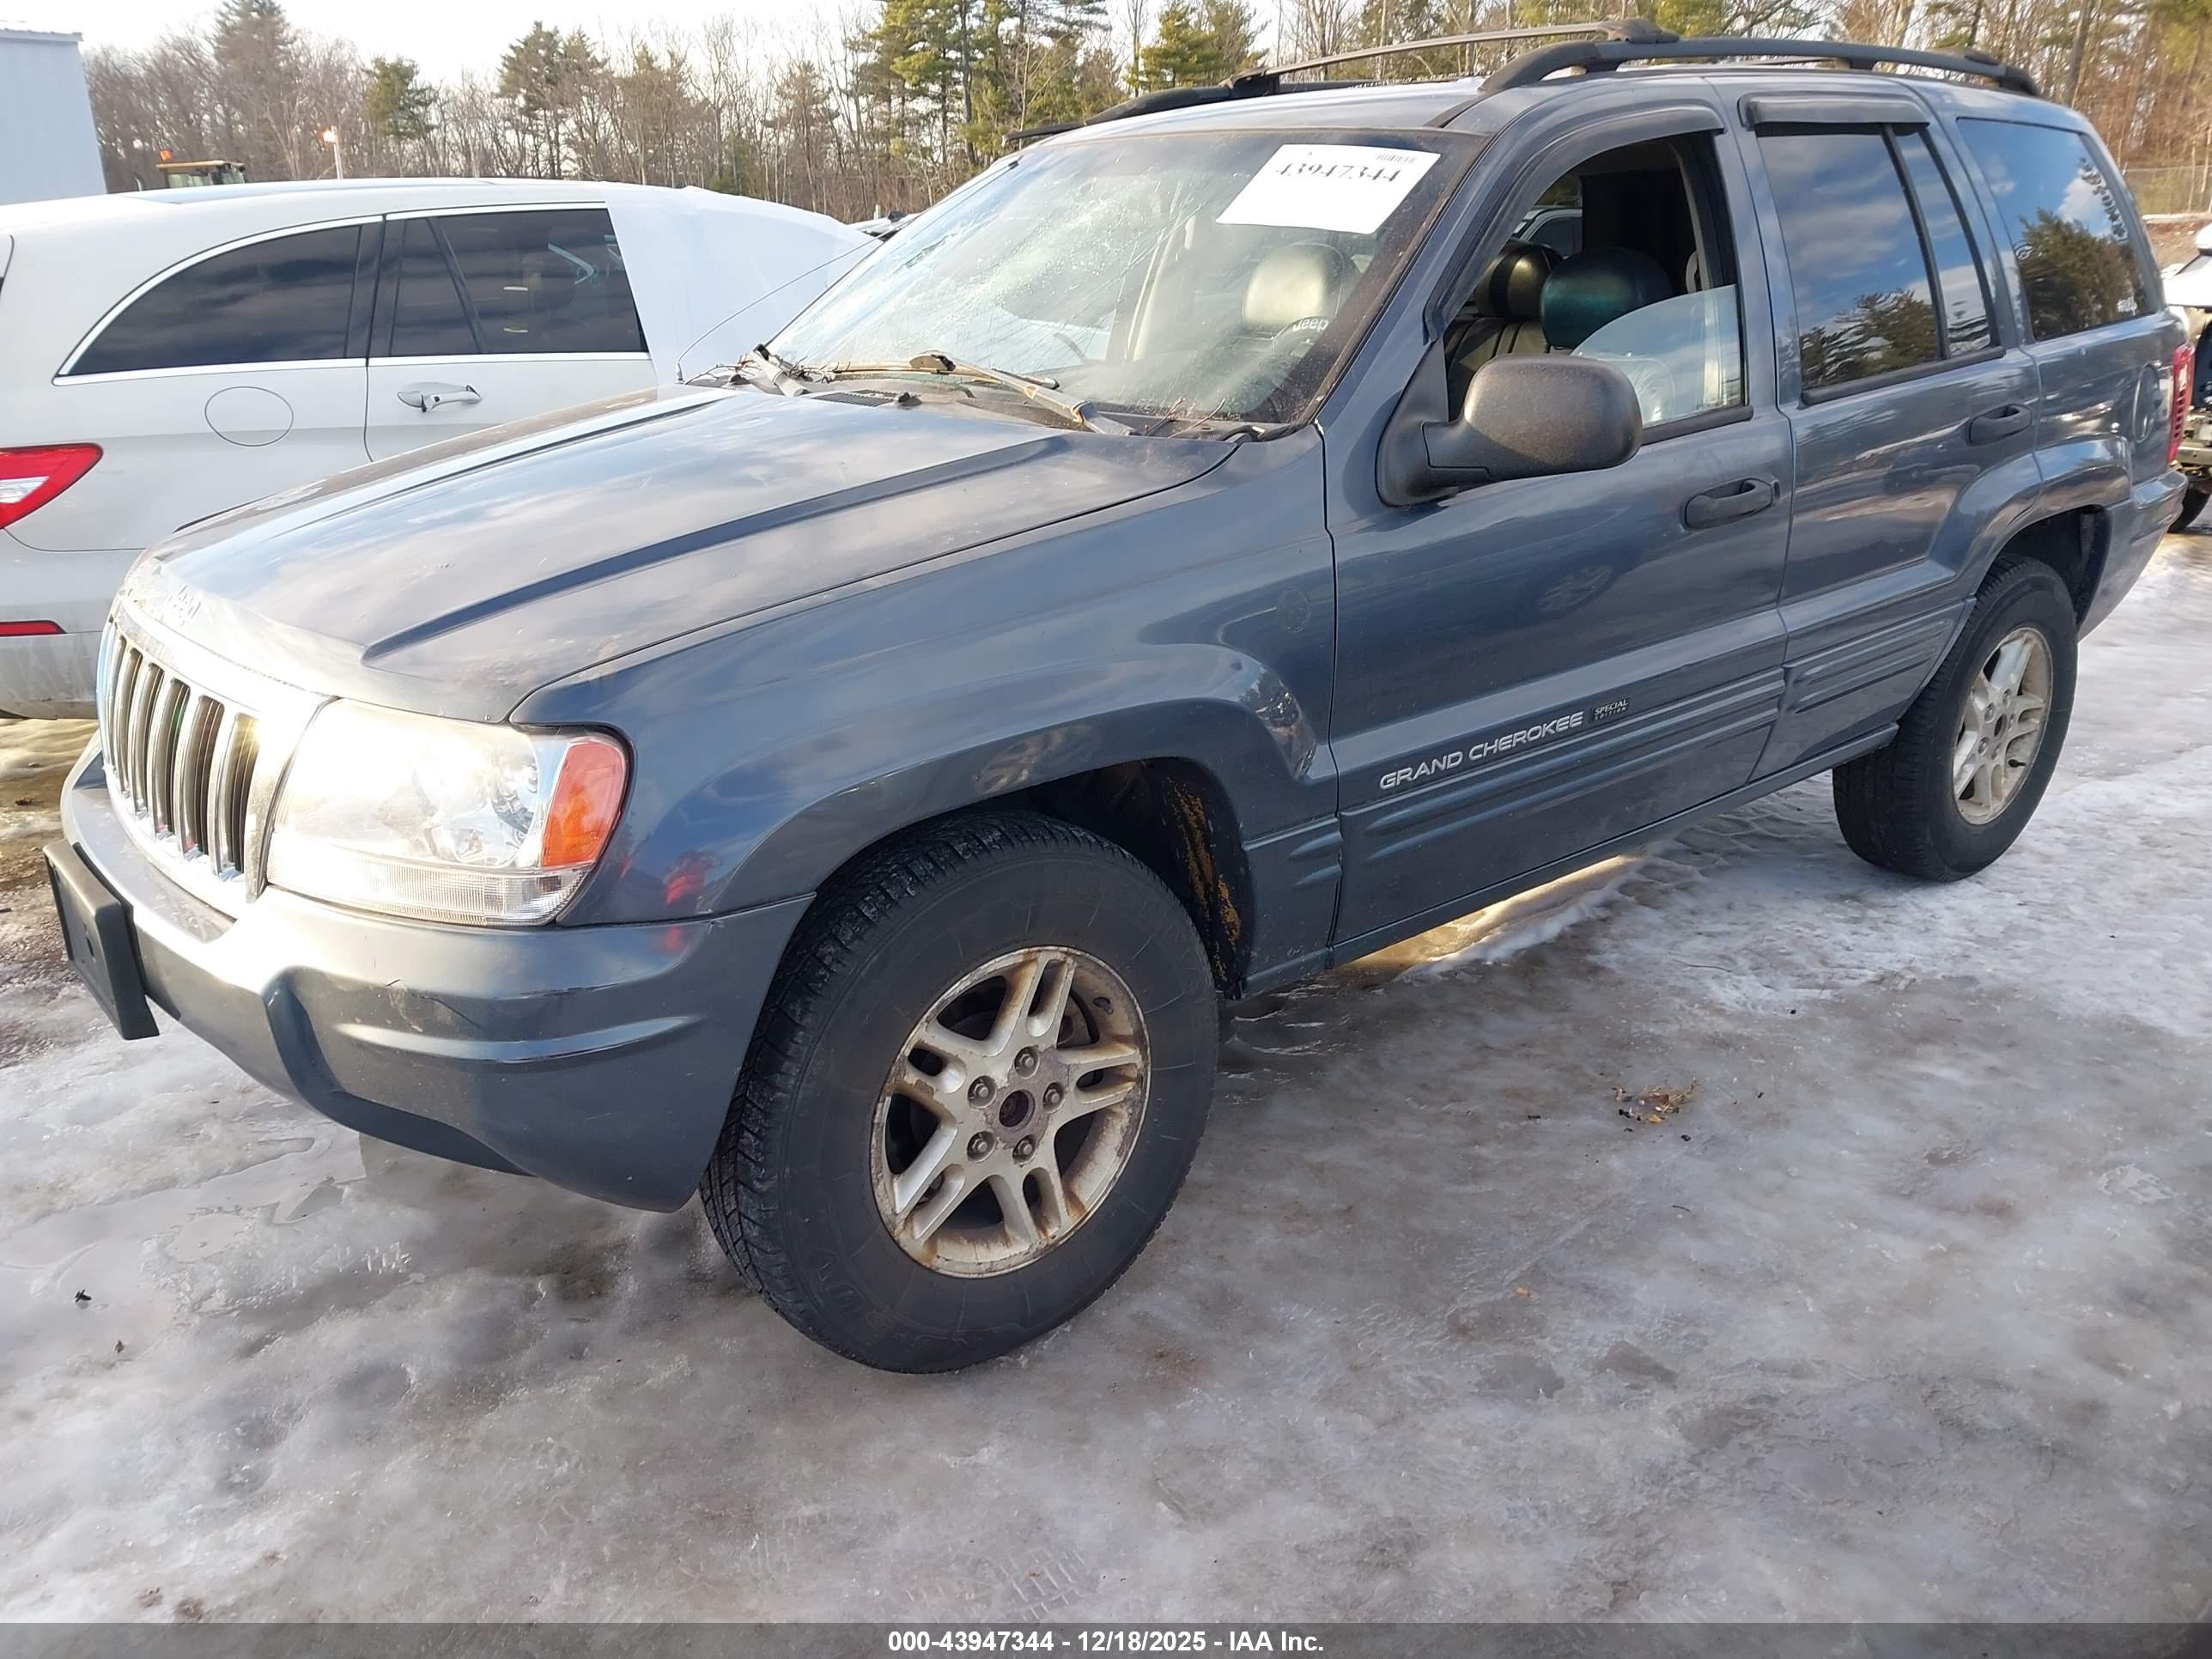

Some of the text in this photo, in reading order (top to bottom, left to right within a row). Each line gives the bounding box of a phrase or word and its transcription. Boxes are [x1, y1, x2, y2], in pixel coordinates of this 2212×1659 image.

[1292, 319, 1329, 332] Jeep
[1595, 699, 1629, 715] SPECIAL
[1379, 711, 1584, 790] GRAND CHEROKEE
